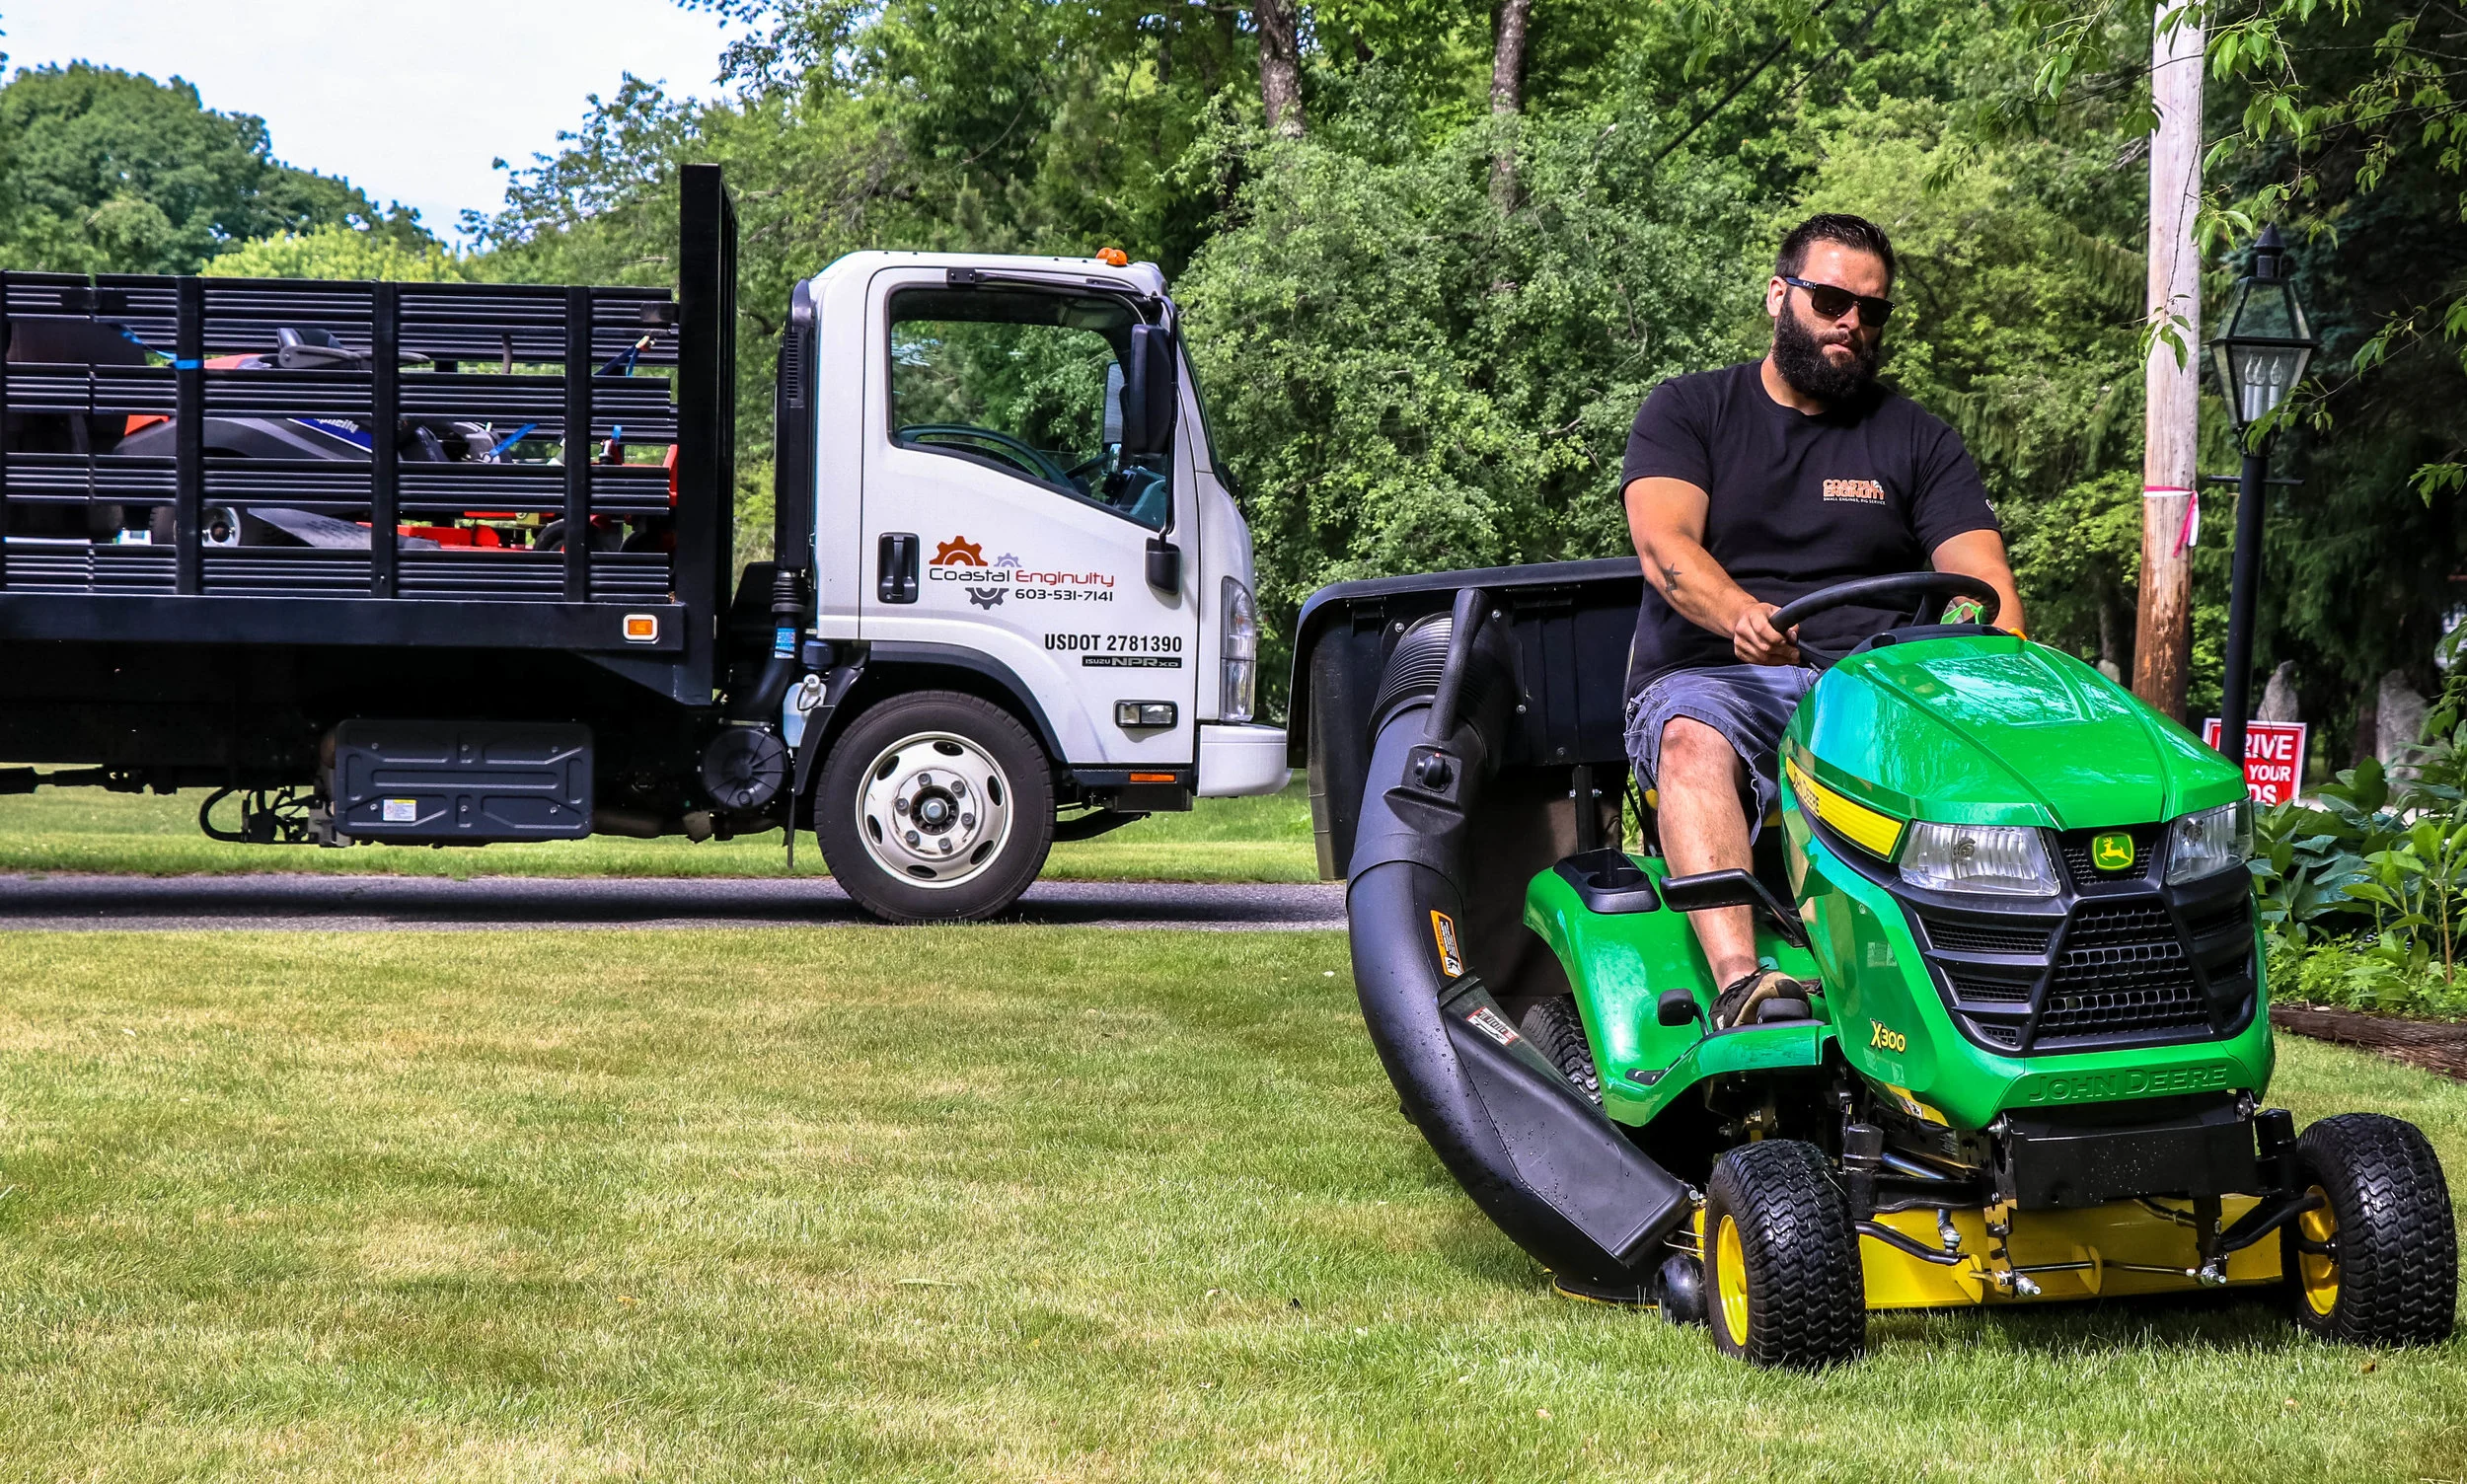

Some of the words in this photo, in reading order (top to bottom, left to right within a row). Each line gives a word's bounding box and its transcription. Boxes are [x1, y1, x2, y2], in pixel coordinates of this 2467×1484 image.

[1823, 480, 1876, 488] COASTAL
[1823, 487, 1885, 500] ENGINUITY
[929, 567, 1010, 583] Coastal
[1015, 569, 1114, 588] Enginuity
[1015, 588, 1113, 602] 603-531-7141
[1045, 633, 1101, 651] USDOT
[1106, 634, 1182, 652] 2781390
[2248, 764, 2291, 781] YOUR
[1870, 1019, 1906, 1053] X300
[2029, 1075, 2117, 1102] JOHN
[2125, 1065, 2228, 1094] DEERE
